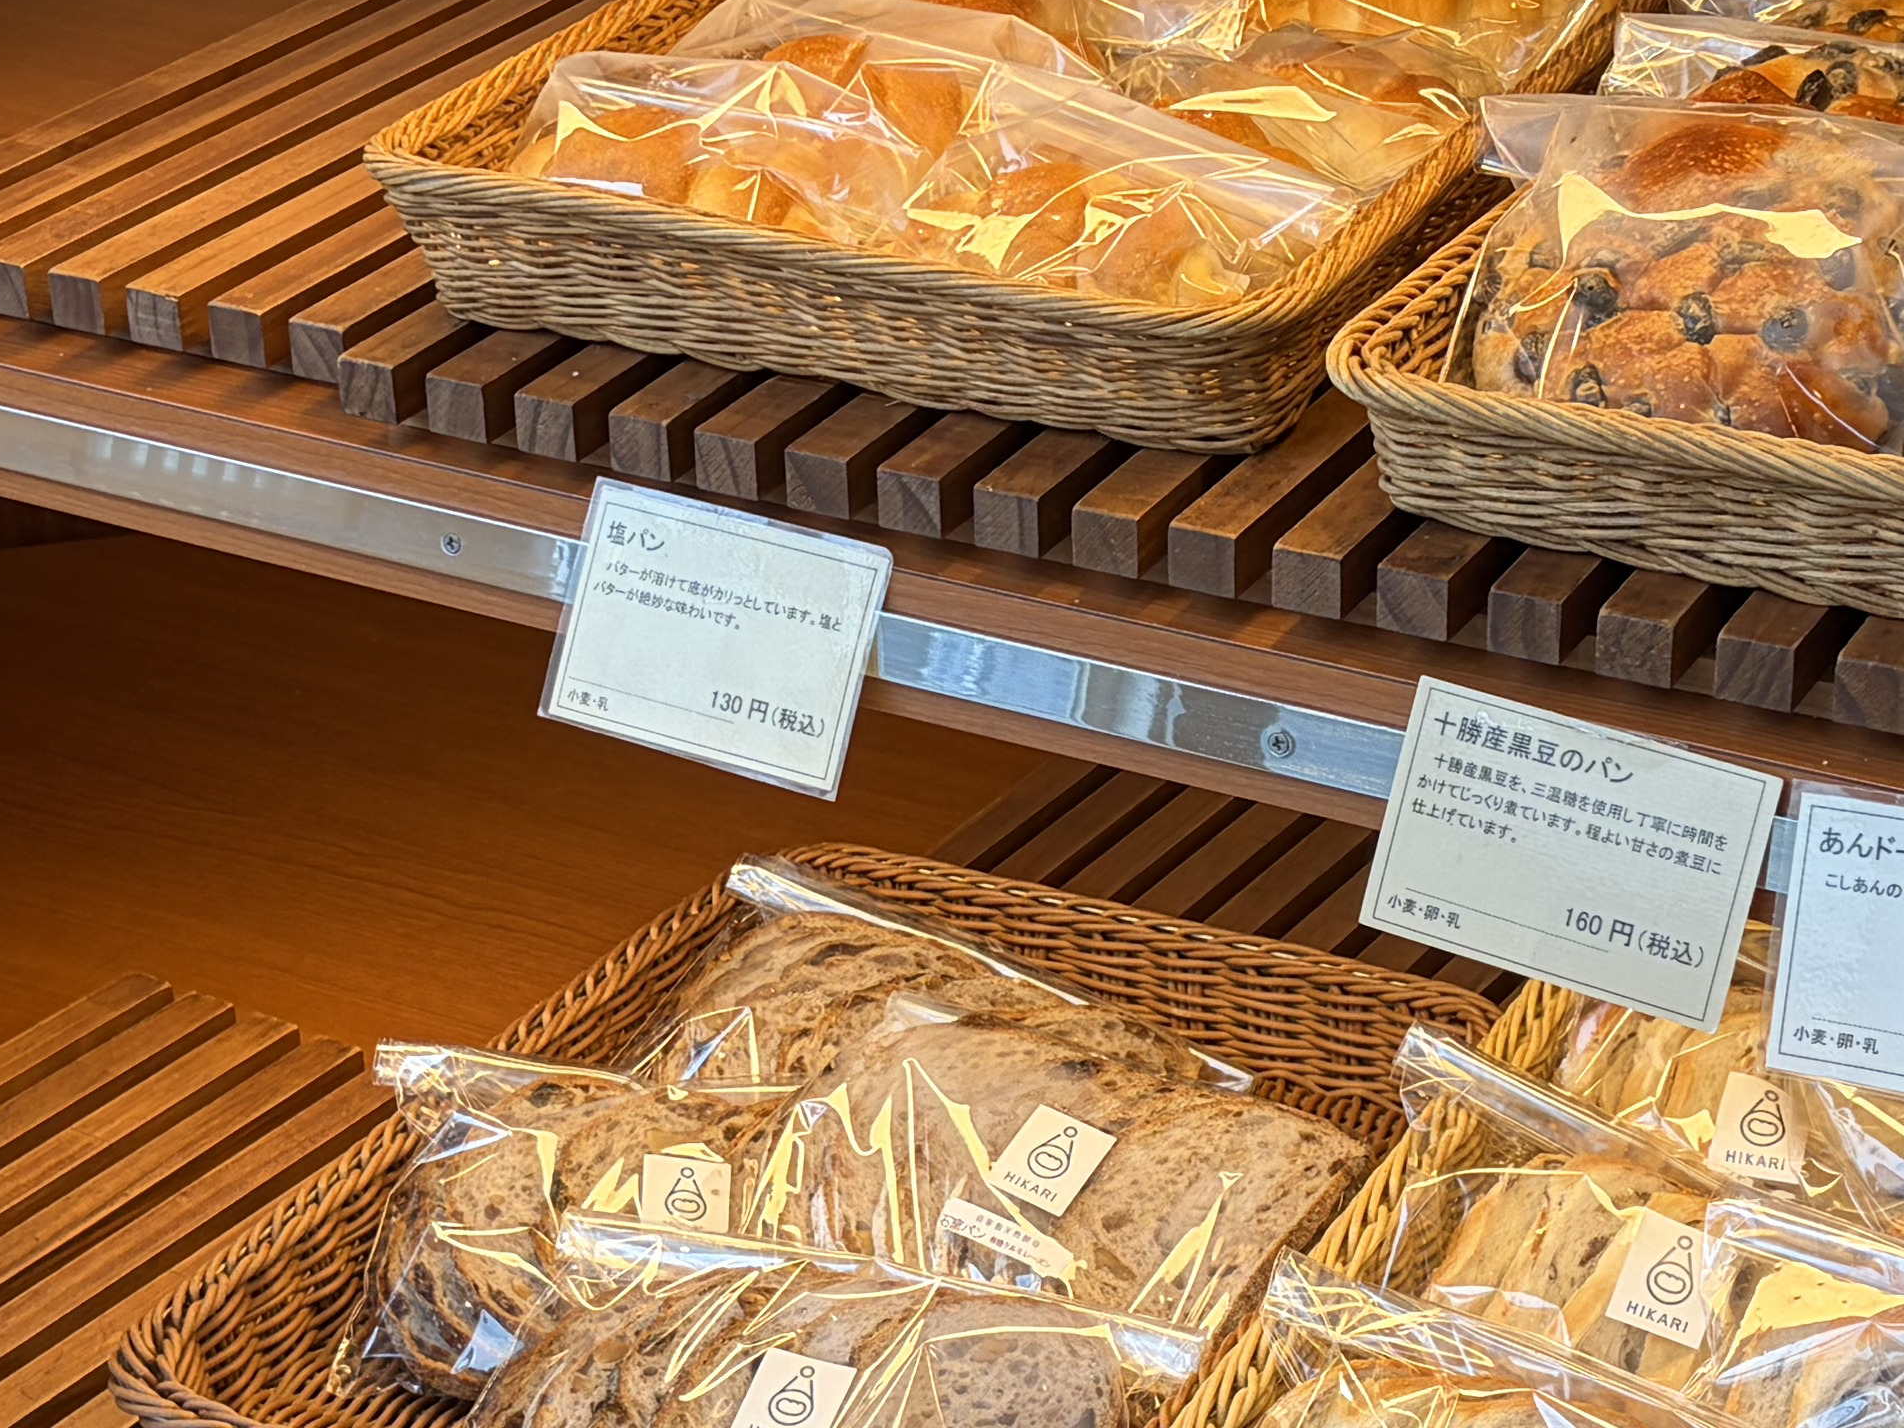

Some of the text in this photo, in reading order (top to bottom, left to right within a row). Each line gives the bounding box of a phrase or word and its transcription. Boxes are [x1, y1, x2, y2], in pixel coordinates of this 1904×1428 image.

[606, 520, 665, 552] 塩パン
[593, 579, 741, 631] バターが絶妙な味わいです。
[1433, 710, 1634, 784] 十勝産黒豆のパン
[1411, 798, 1519, 845] 仕上げています。
[1433, 753, 1729, 852] 十勝産黒豆を、三温糖を使用し丁寧に時間を
[1416, 774, 1722, 875] かけてじっくり煮ています。程よい甘さの煮豆に
[1793, 1025, 1880, 1056] 小麦・卵・乳
[1725, 1149, 1786, 1171] HIKARI
[1003, 1170, 1059, 1203] HIKARI
[1625, 1300, 1689, 1334] HIKARI
